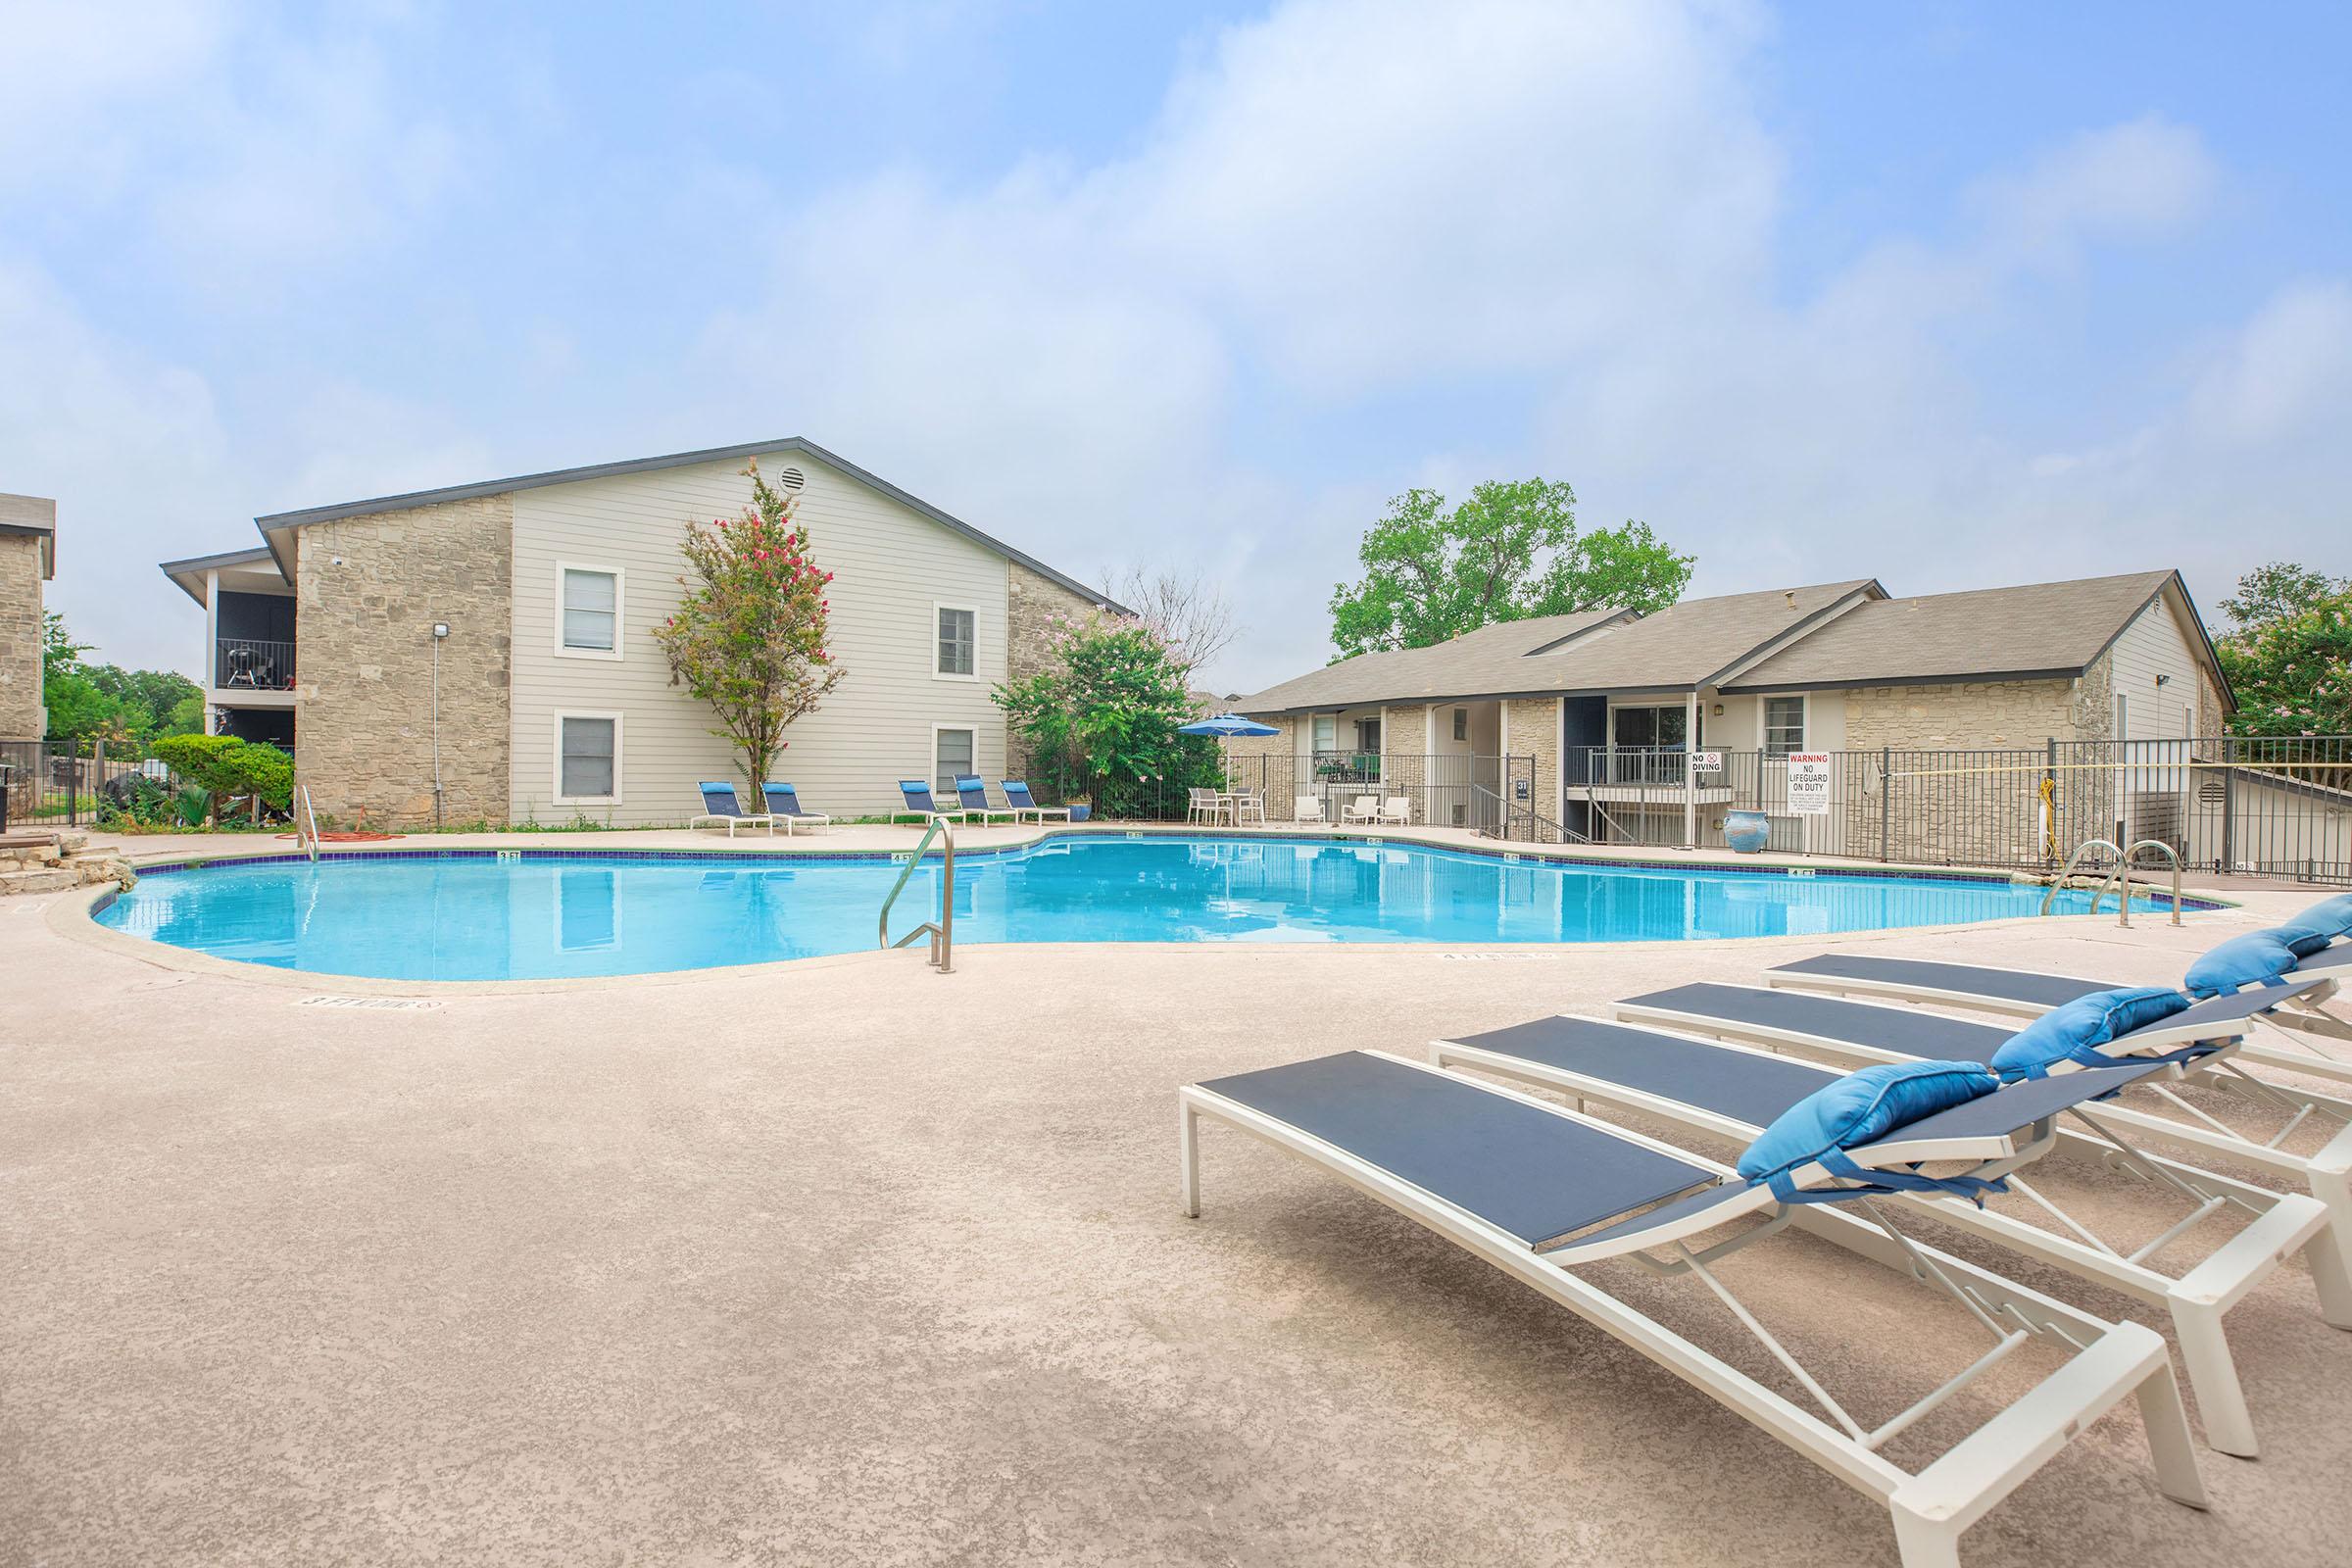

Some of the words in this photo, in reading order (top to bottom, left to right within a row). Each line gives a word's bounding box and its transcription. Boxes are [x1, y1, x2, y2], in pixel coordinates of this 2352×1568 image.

[1518, 781, 1527, 790] 31
[500, 852, 507, 861] 3
[510, 852, 519, 862] FT
